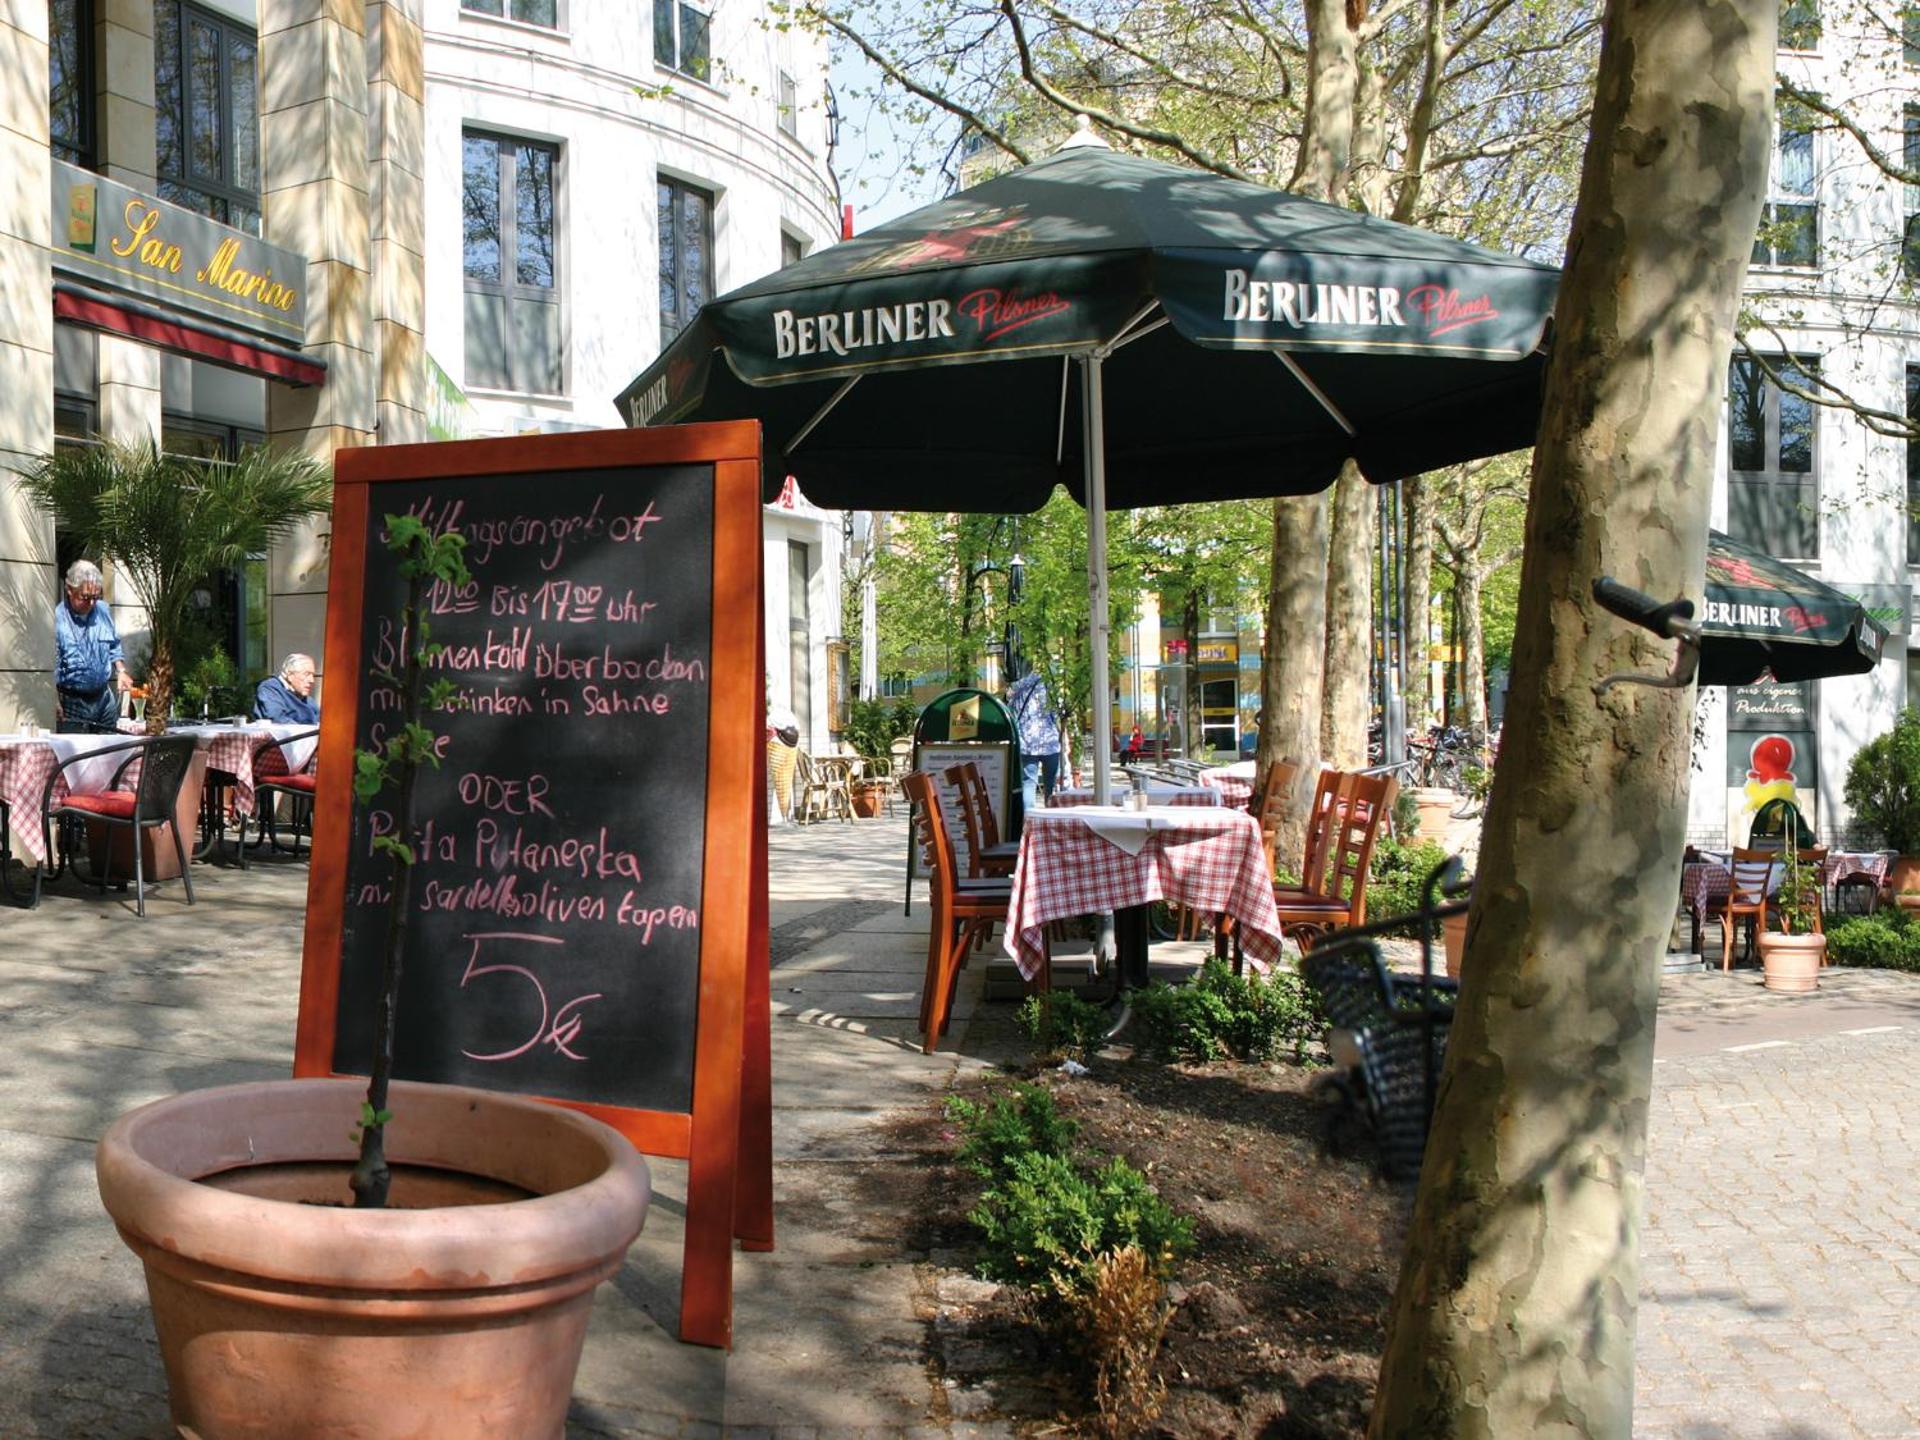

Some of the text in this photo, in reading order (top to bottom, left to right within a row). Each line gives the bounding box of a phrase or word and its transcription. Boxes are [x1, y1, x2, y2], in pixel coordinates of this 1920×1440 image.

[111, 200, 183, 273] San
[197, 236, 297, 312] Marino
[1223, 268, 1408, 329] BERLINER
[772, 300, 955, 361] BERLINER
[541, 688, 570, 715] in
[581, 684, 670, 717] Sahne
[1735, 699, 1807, 715] Produktion
[458, 772, 556, 820] ODER
[457, 931, 604, 1062] 5€
